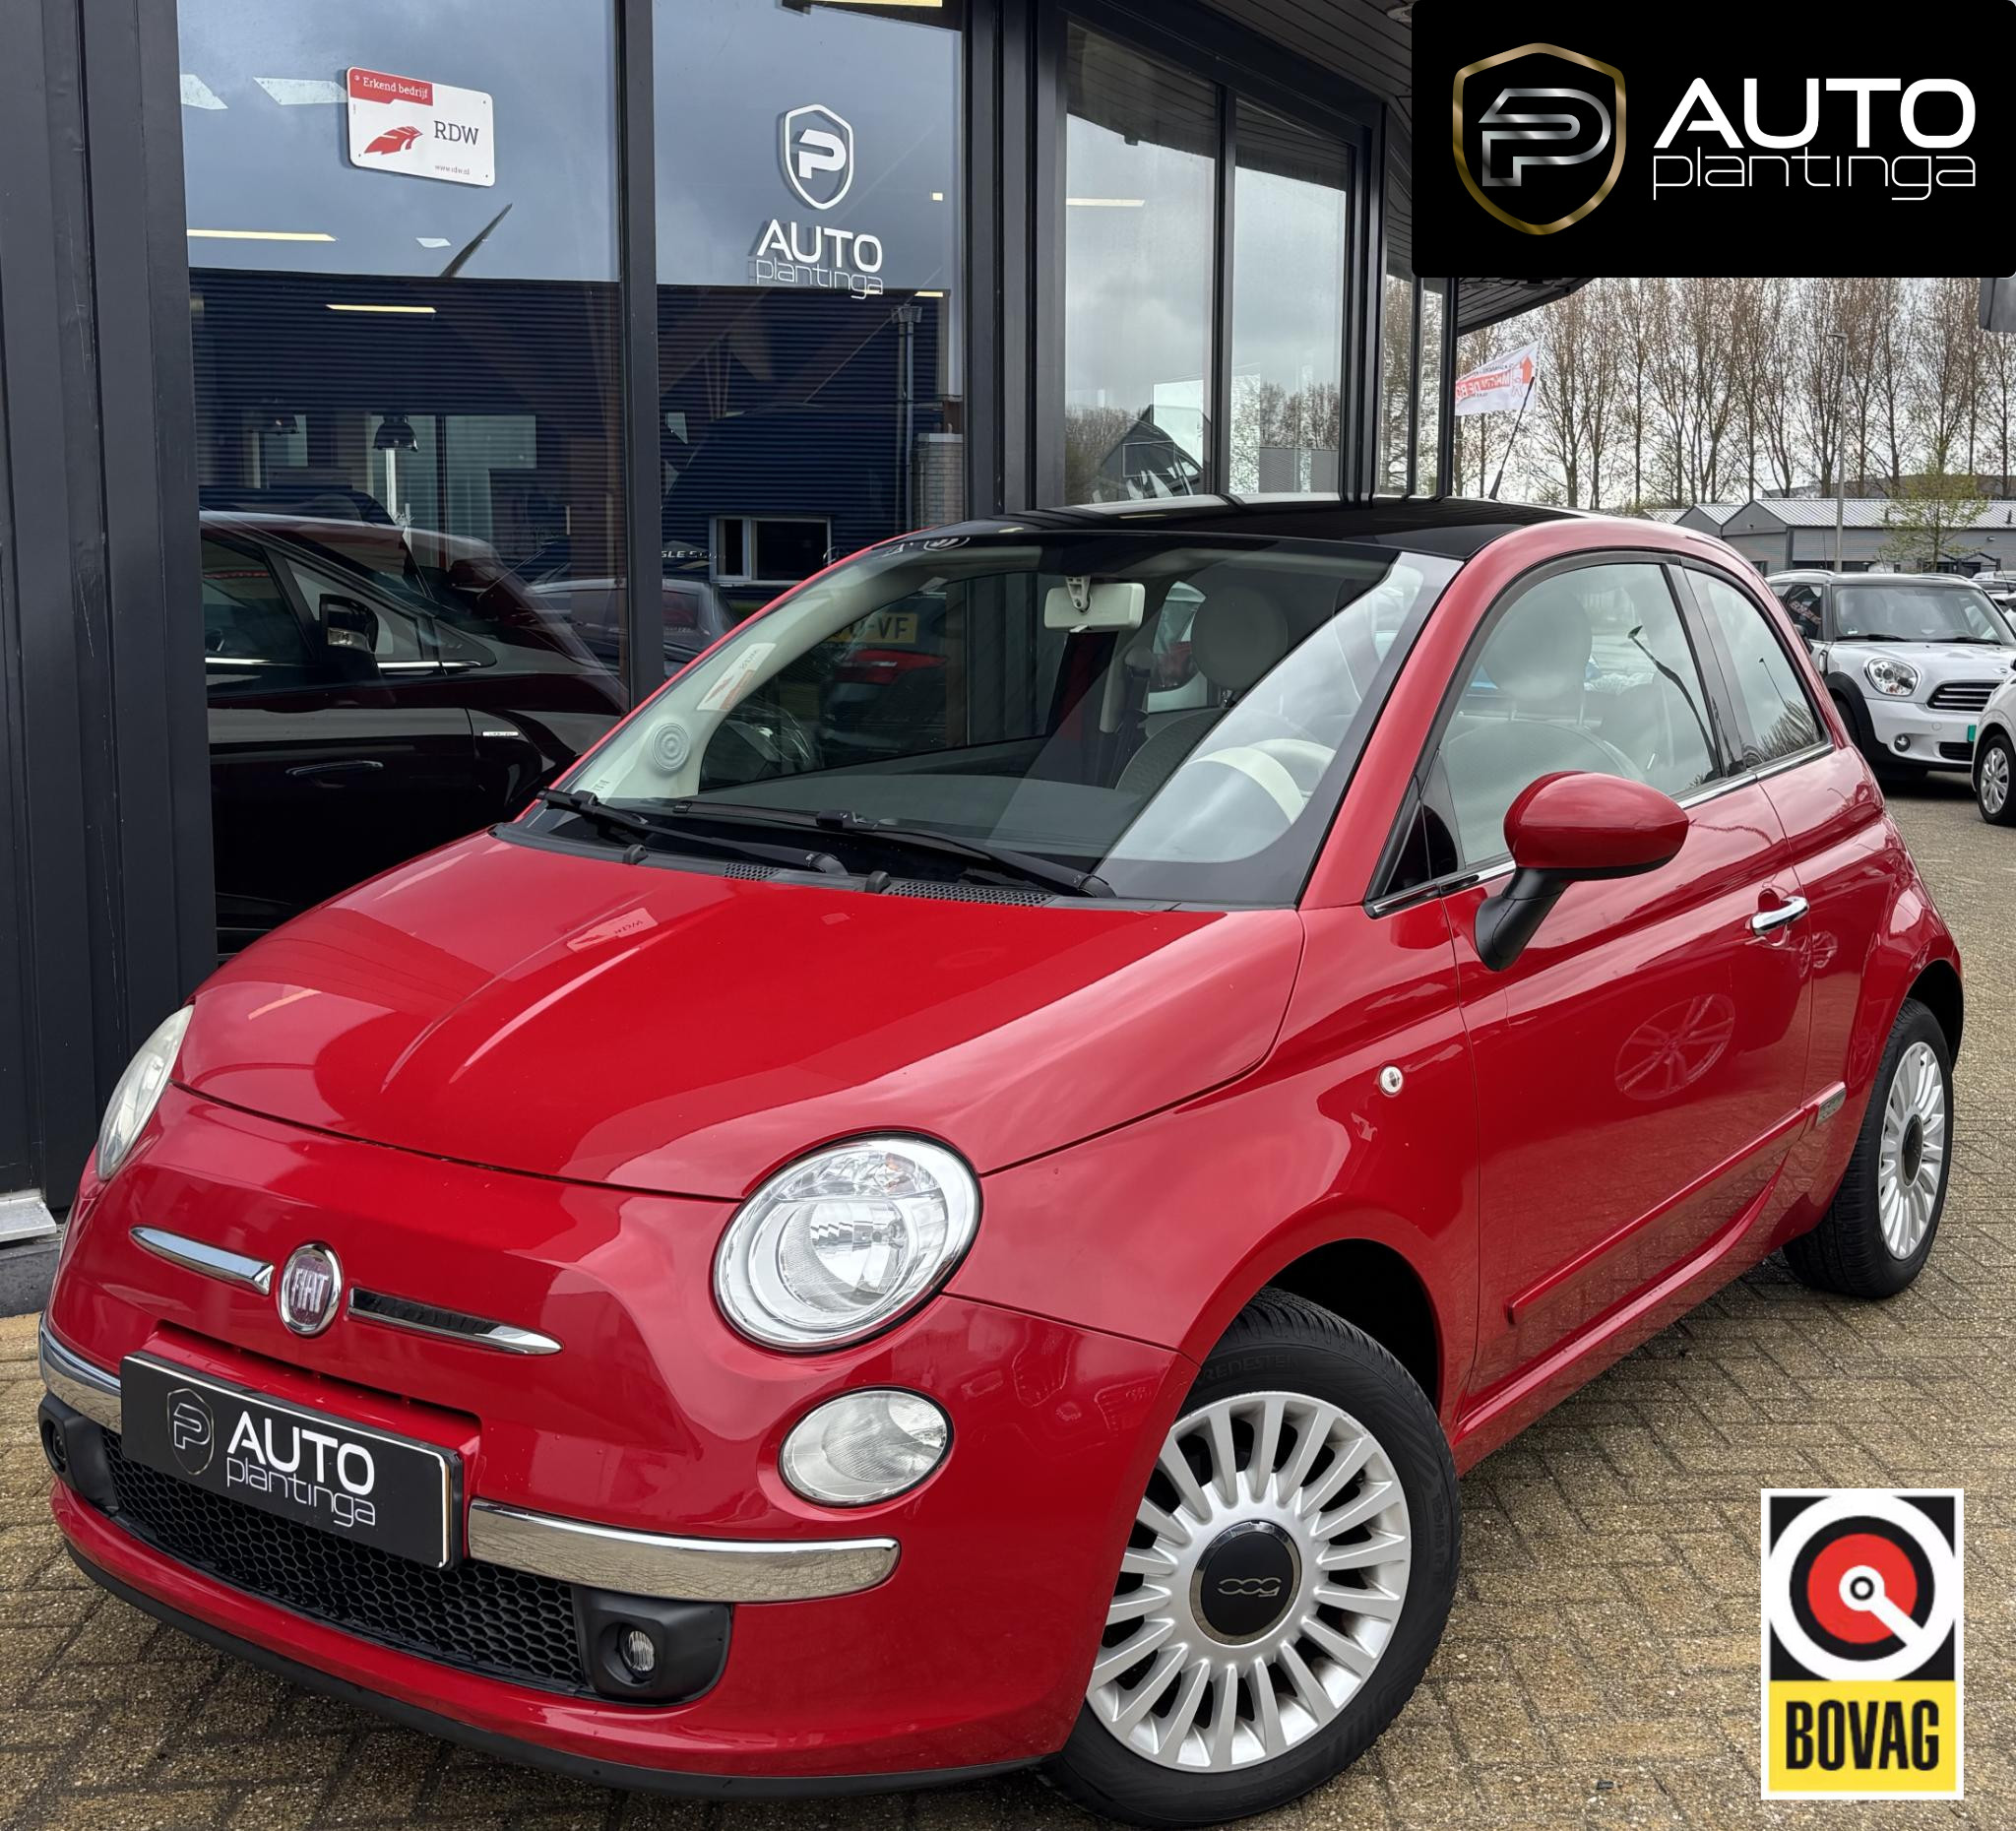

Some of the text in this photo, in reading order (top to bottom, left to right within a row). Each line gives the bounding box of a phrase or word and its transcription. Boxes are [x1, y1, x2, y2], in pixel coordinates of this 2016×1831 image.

[362, 77, 428, 100] Erkend bedrijf
[433, 120, 479, 146] RDW
[756, 219, 883, 273] AUTO
[756, 257, 884, 299] plantinga
[289, 1267, 330, 1314] FIAT
[226, 1411, 375, 1496] AUTO
[226, 1457, 376, 1528] plantinga
